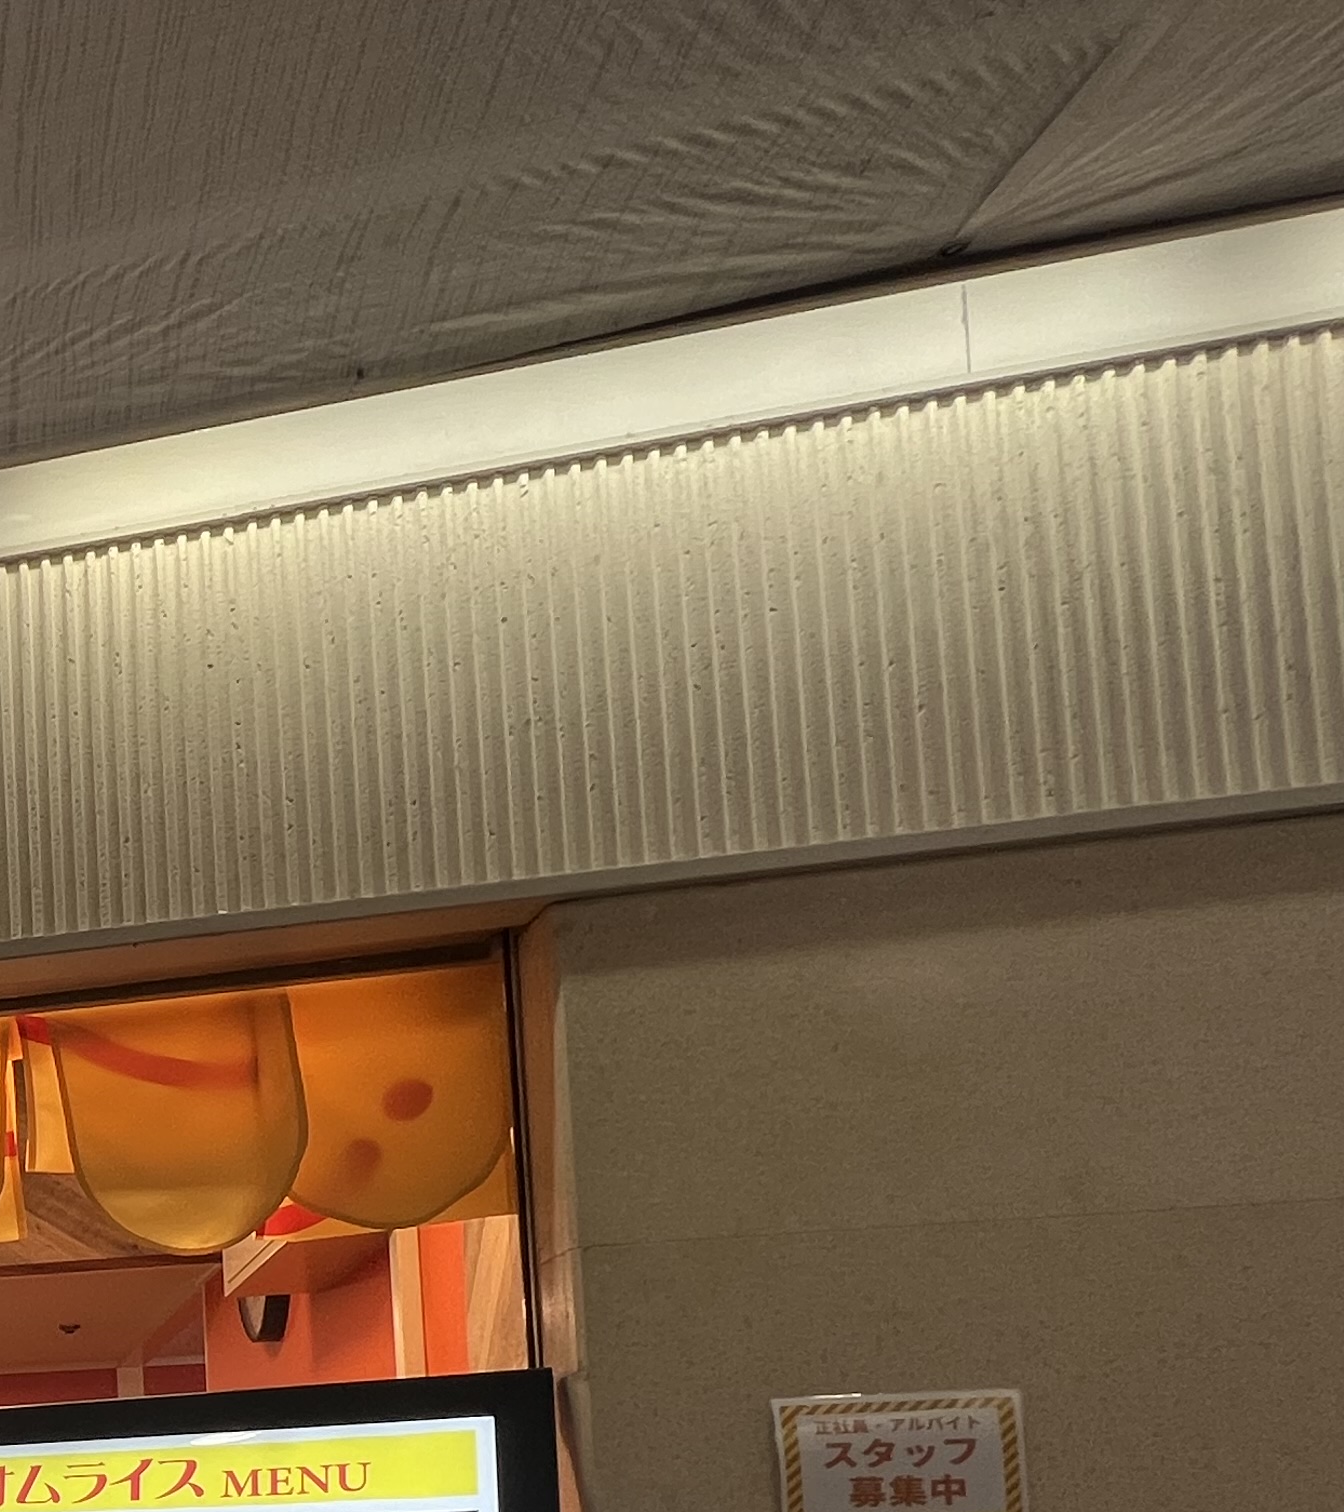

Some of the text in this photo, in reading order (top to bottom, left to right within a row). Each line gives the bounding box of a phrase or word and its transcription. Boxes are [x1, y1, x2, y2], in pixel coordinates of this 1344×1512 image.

[824, 1437, 977, 1469] スタッフ
[220, 1461, 372, 1499] MENU
[848, 1474, 967, 1508] 募集中
